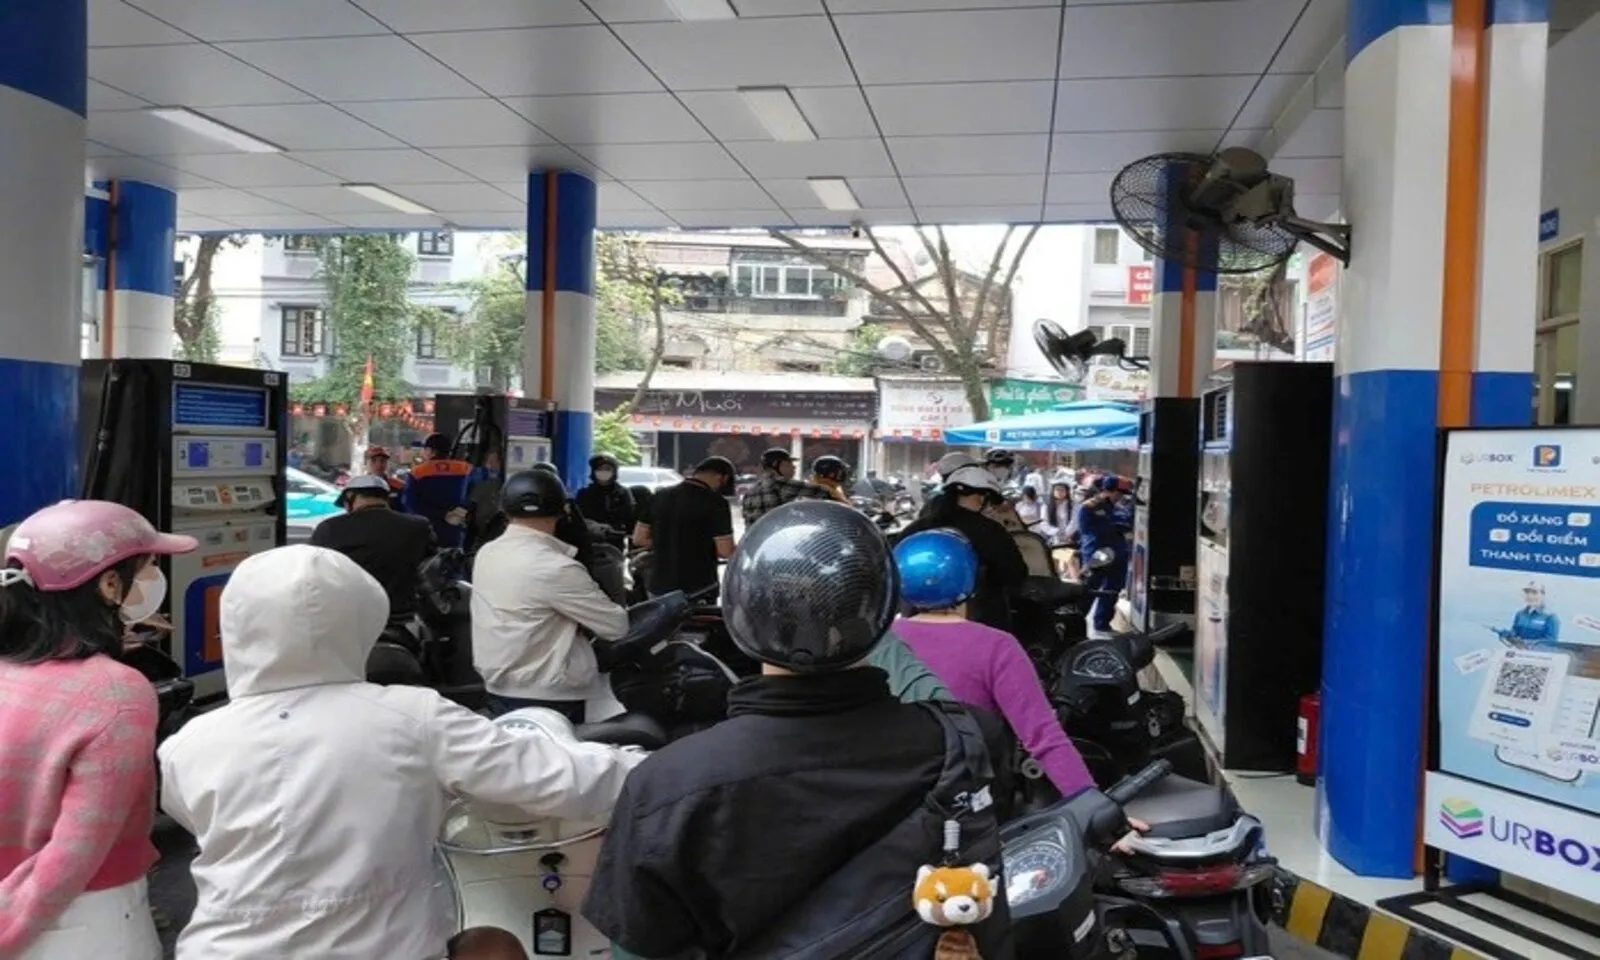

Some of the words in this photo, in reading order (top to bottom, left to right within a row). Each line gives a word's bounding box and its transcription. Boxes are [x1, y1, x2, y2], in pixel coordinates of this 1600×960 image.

[1470, 483, 1597, 498] PETROLIMEX
[1521, 513, 1564, 526] XĂNG
[1481, 549, 1531, 562] THANH
[1534, 551, 1576, 566] TOÁN
